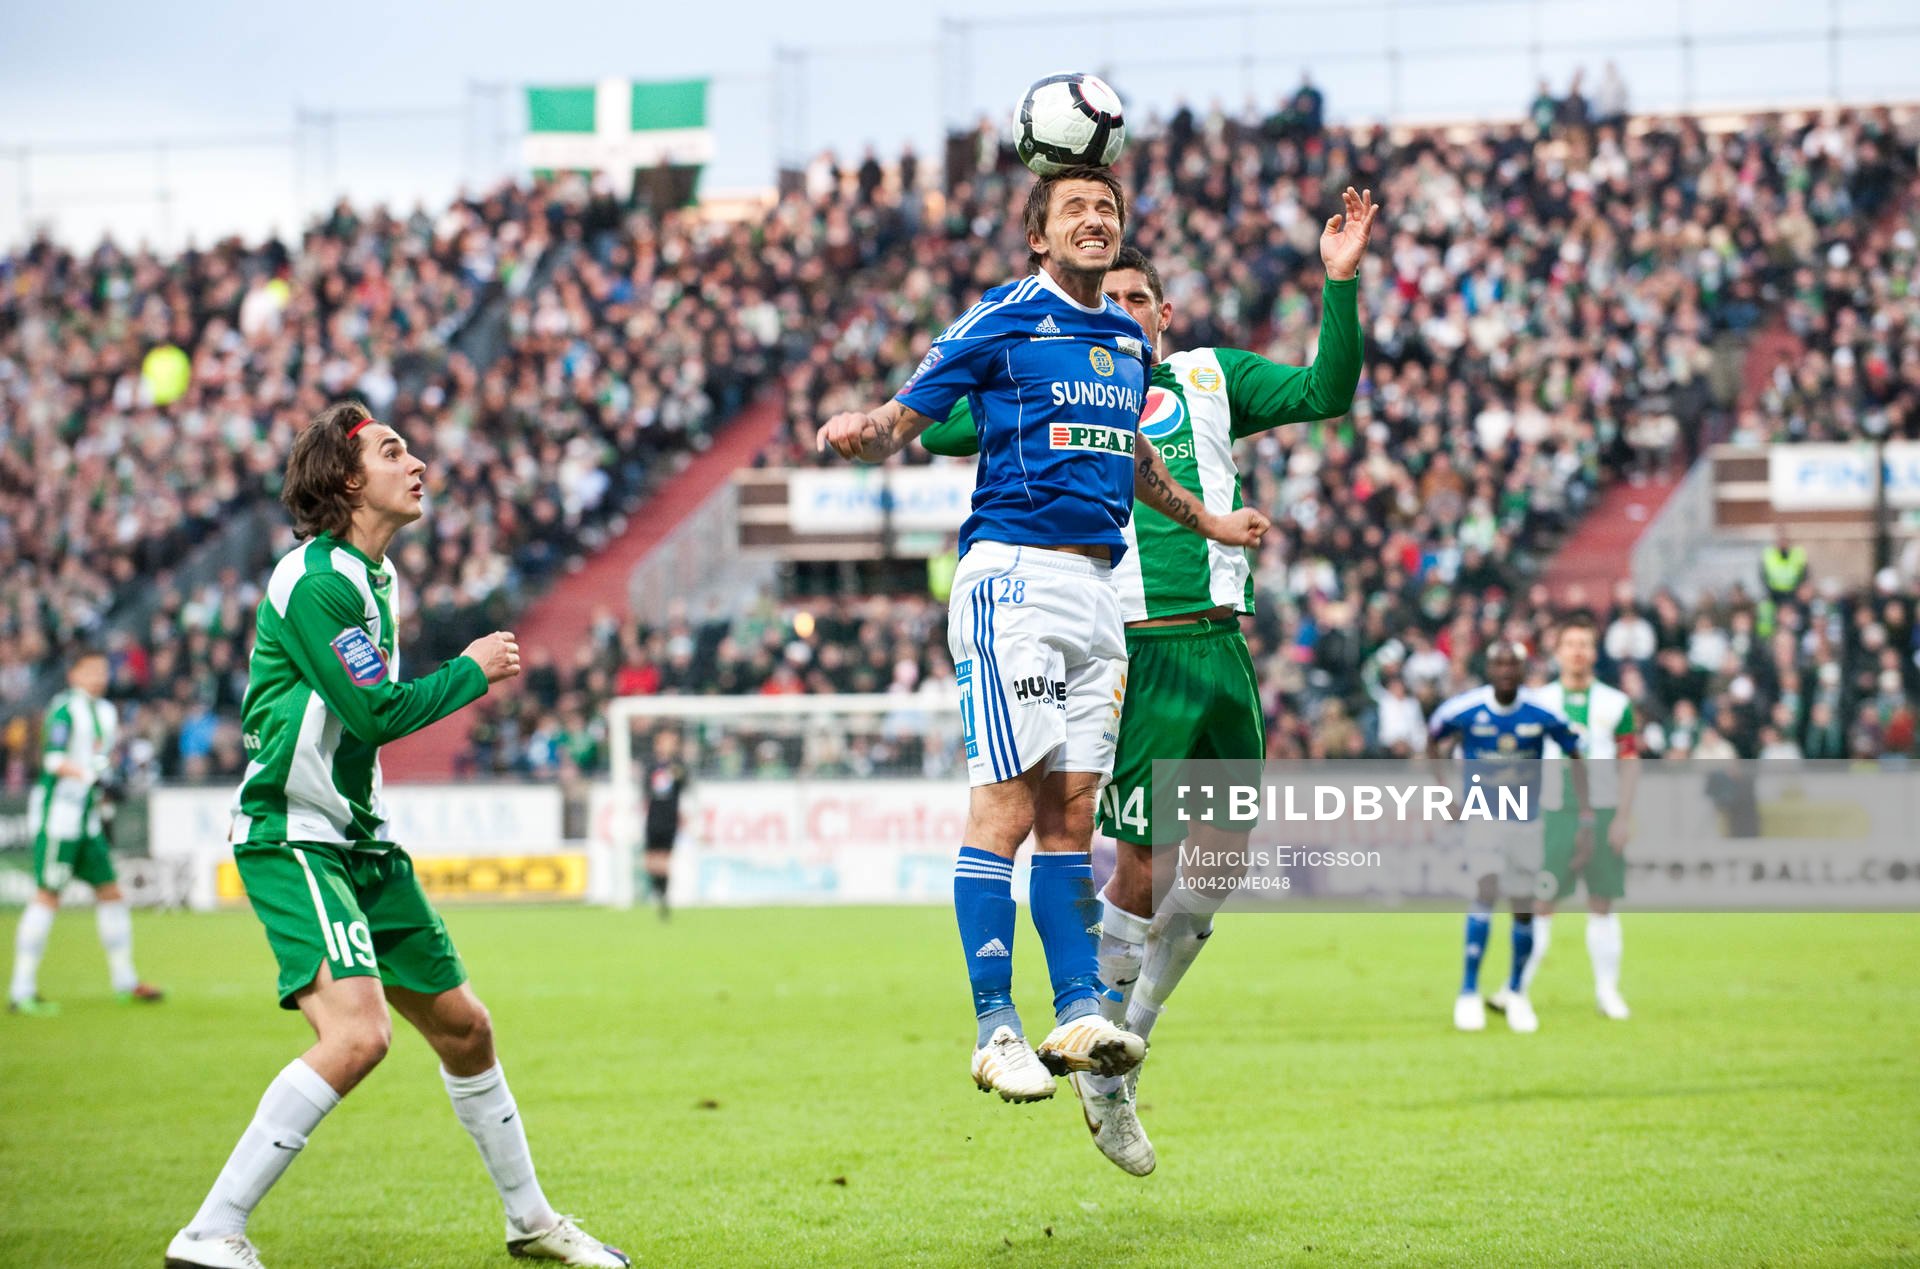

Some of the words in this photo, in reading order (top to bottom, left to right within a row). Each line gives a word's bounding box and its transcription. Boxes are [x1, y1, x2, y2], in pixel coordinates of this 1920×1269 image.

[1035, 326, 1061, 334] adidas
[997, 578, 1026, 604] 28
[1108, 783, 1149, 836] 14
[332, 920, 377, 968] 19
[976, 949, 1009, 957] adidas
